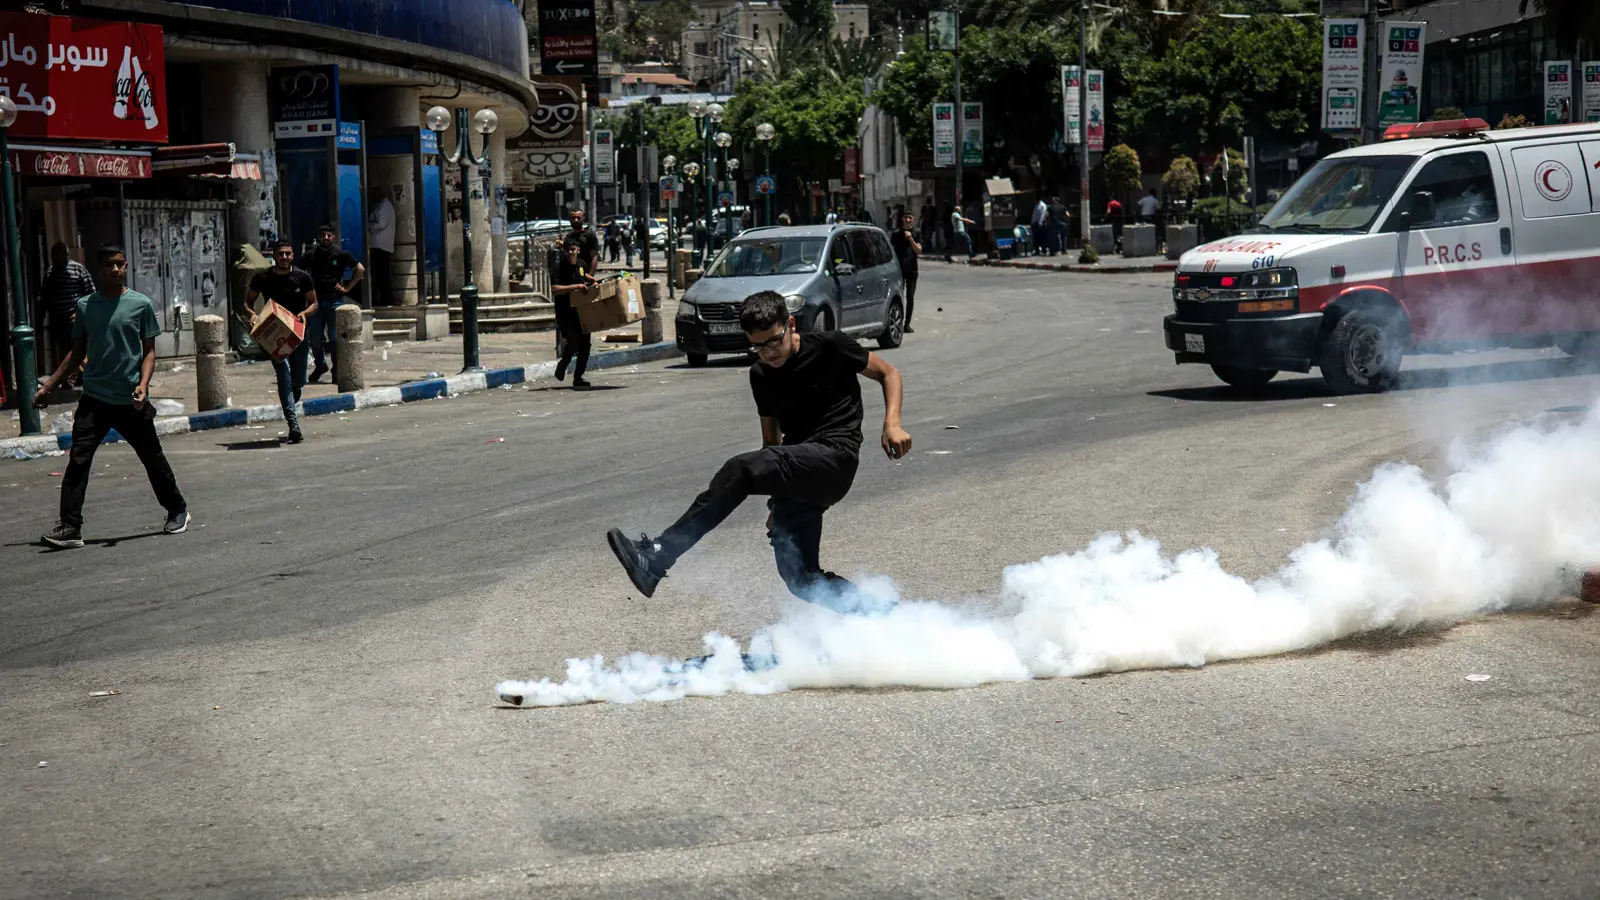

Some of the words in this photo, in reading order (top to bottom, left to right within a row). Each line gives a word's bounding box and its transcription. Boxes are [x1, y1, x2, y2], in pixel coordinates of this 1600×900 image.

[543, 8, 590, 20] TUXEDO
[0, 32, 37, 67] مار
[45, 43, 108, 72] سوبر
[281, 111, 305, 119] ARAB
[35, 154, 71, 174] Coca-Cola
[96, 156, 131, 176] Coca-Cola
[1252, 255, 1275, 269] 610
[1424, 241, 1482, 266] P.R.C.S
